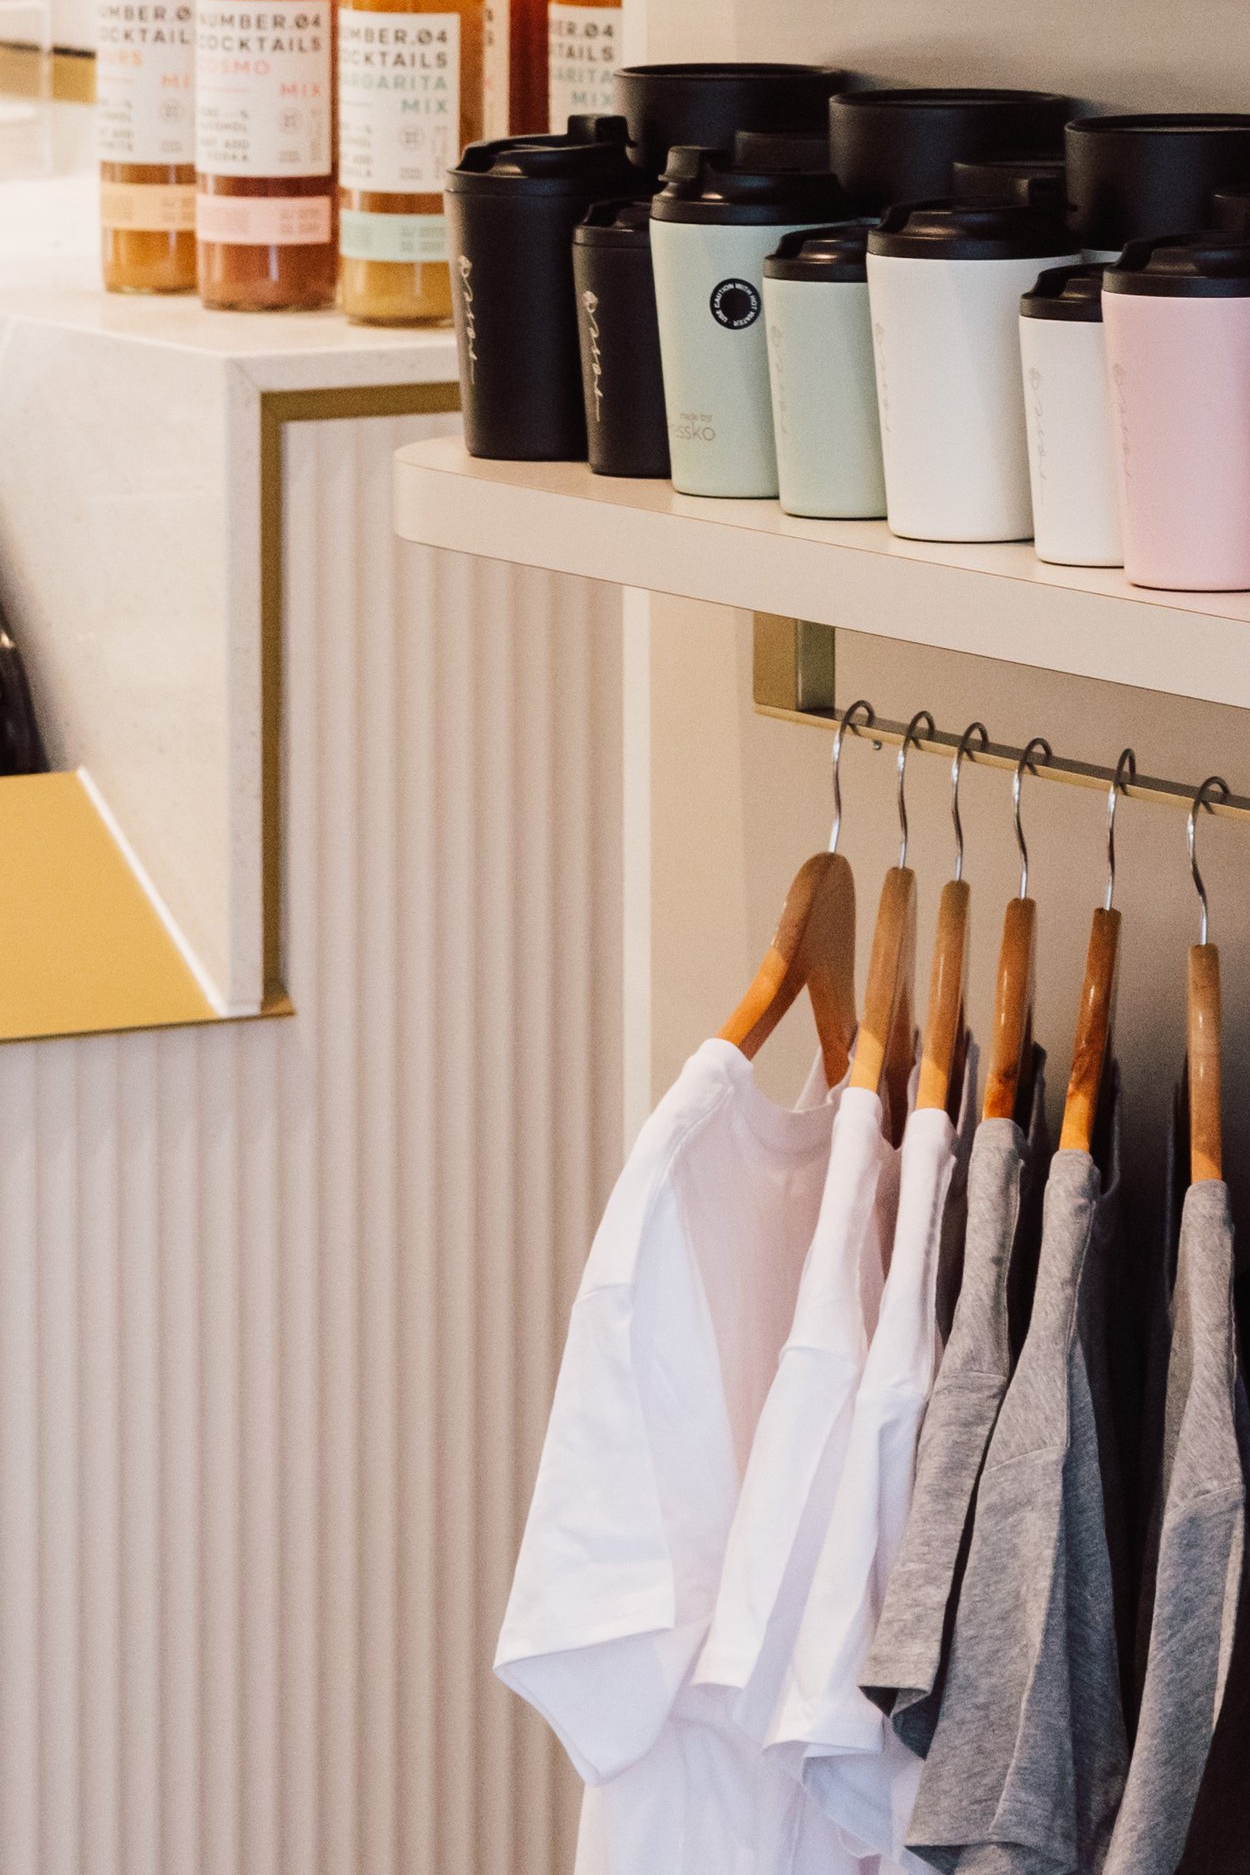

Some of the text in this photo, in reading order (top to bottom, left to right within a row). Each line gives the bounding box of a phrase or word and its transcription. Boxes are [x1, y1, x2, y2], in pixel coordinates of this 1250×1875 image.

[200, 35, 322, 53] COCKTAILS
[279, 82, 322, 97] MIX
[401, 99, 449, 114] MIX
[714, 282, 758, 327] CAUTION WITH HOT WATER USE
